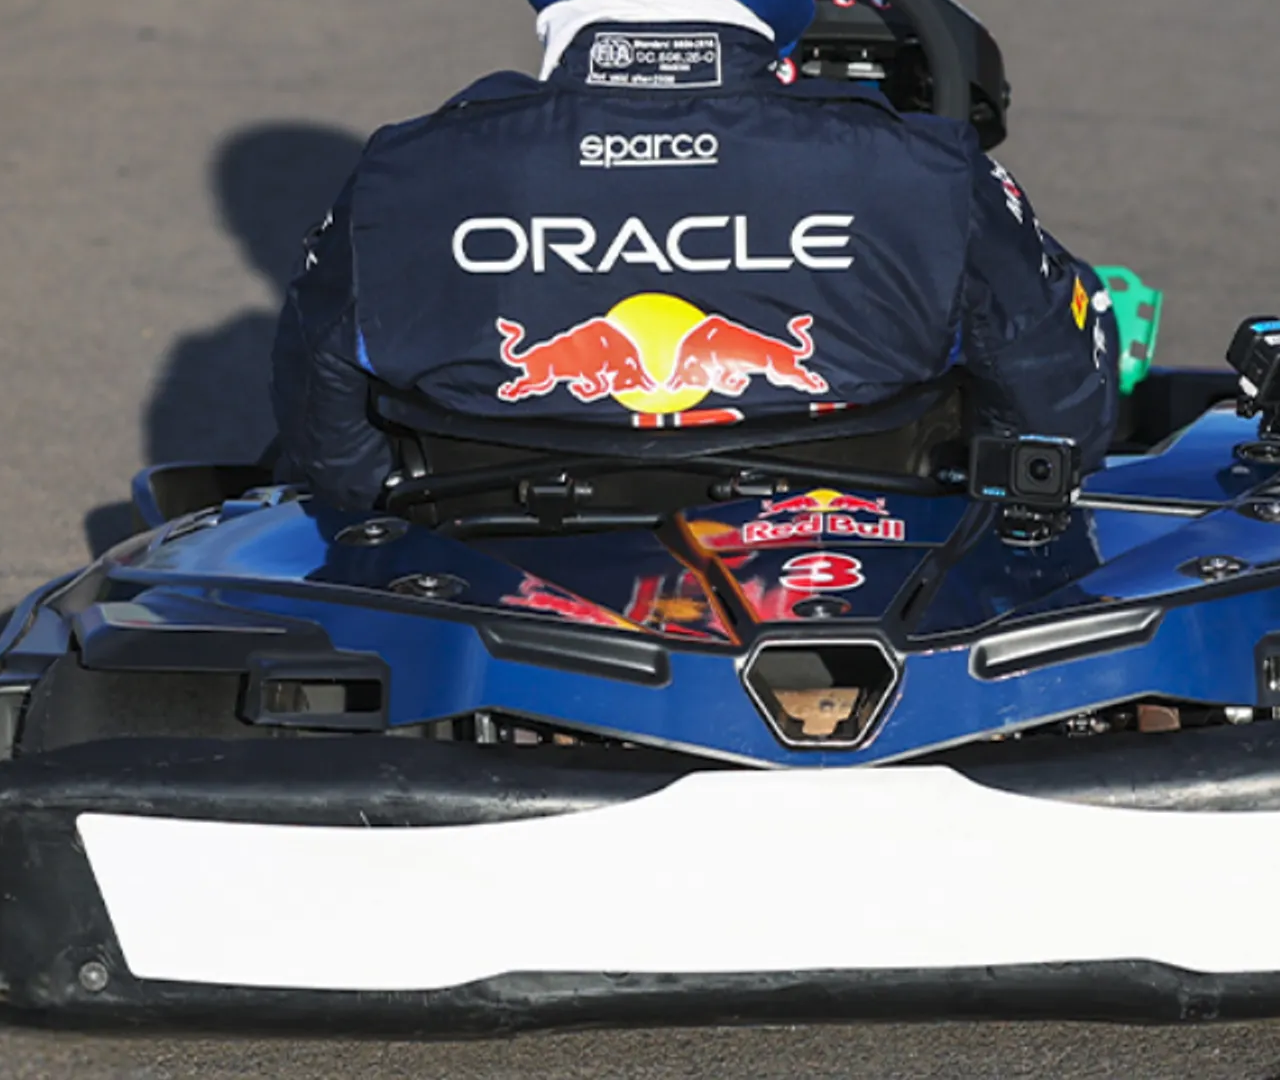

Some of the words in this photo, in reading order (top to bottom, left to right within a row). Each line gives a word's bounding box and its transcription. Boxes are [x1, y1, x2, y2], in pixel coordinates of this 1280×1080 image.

[579, 133, 719, 168] sparco
[451, 215, 855, 273] ORACLE
[742, 512, 824, 544] Red
[827, 513, 906, 542] Bull
[778, 550, 867, 593] 3
